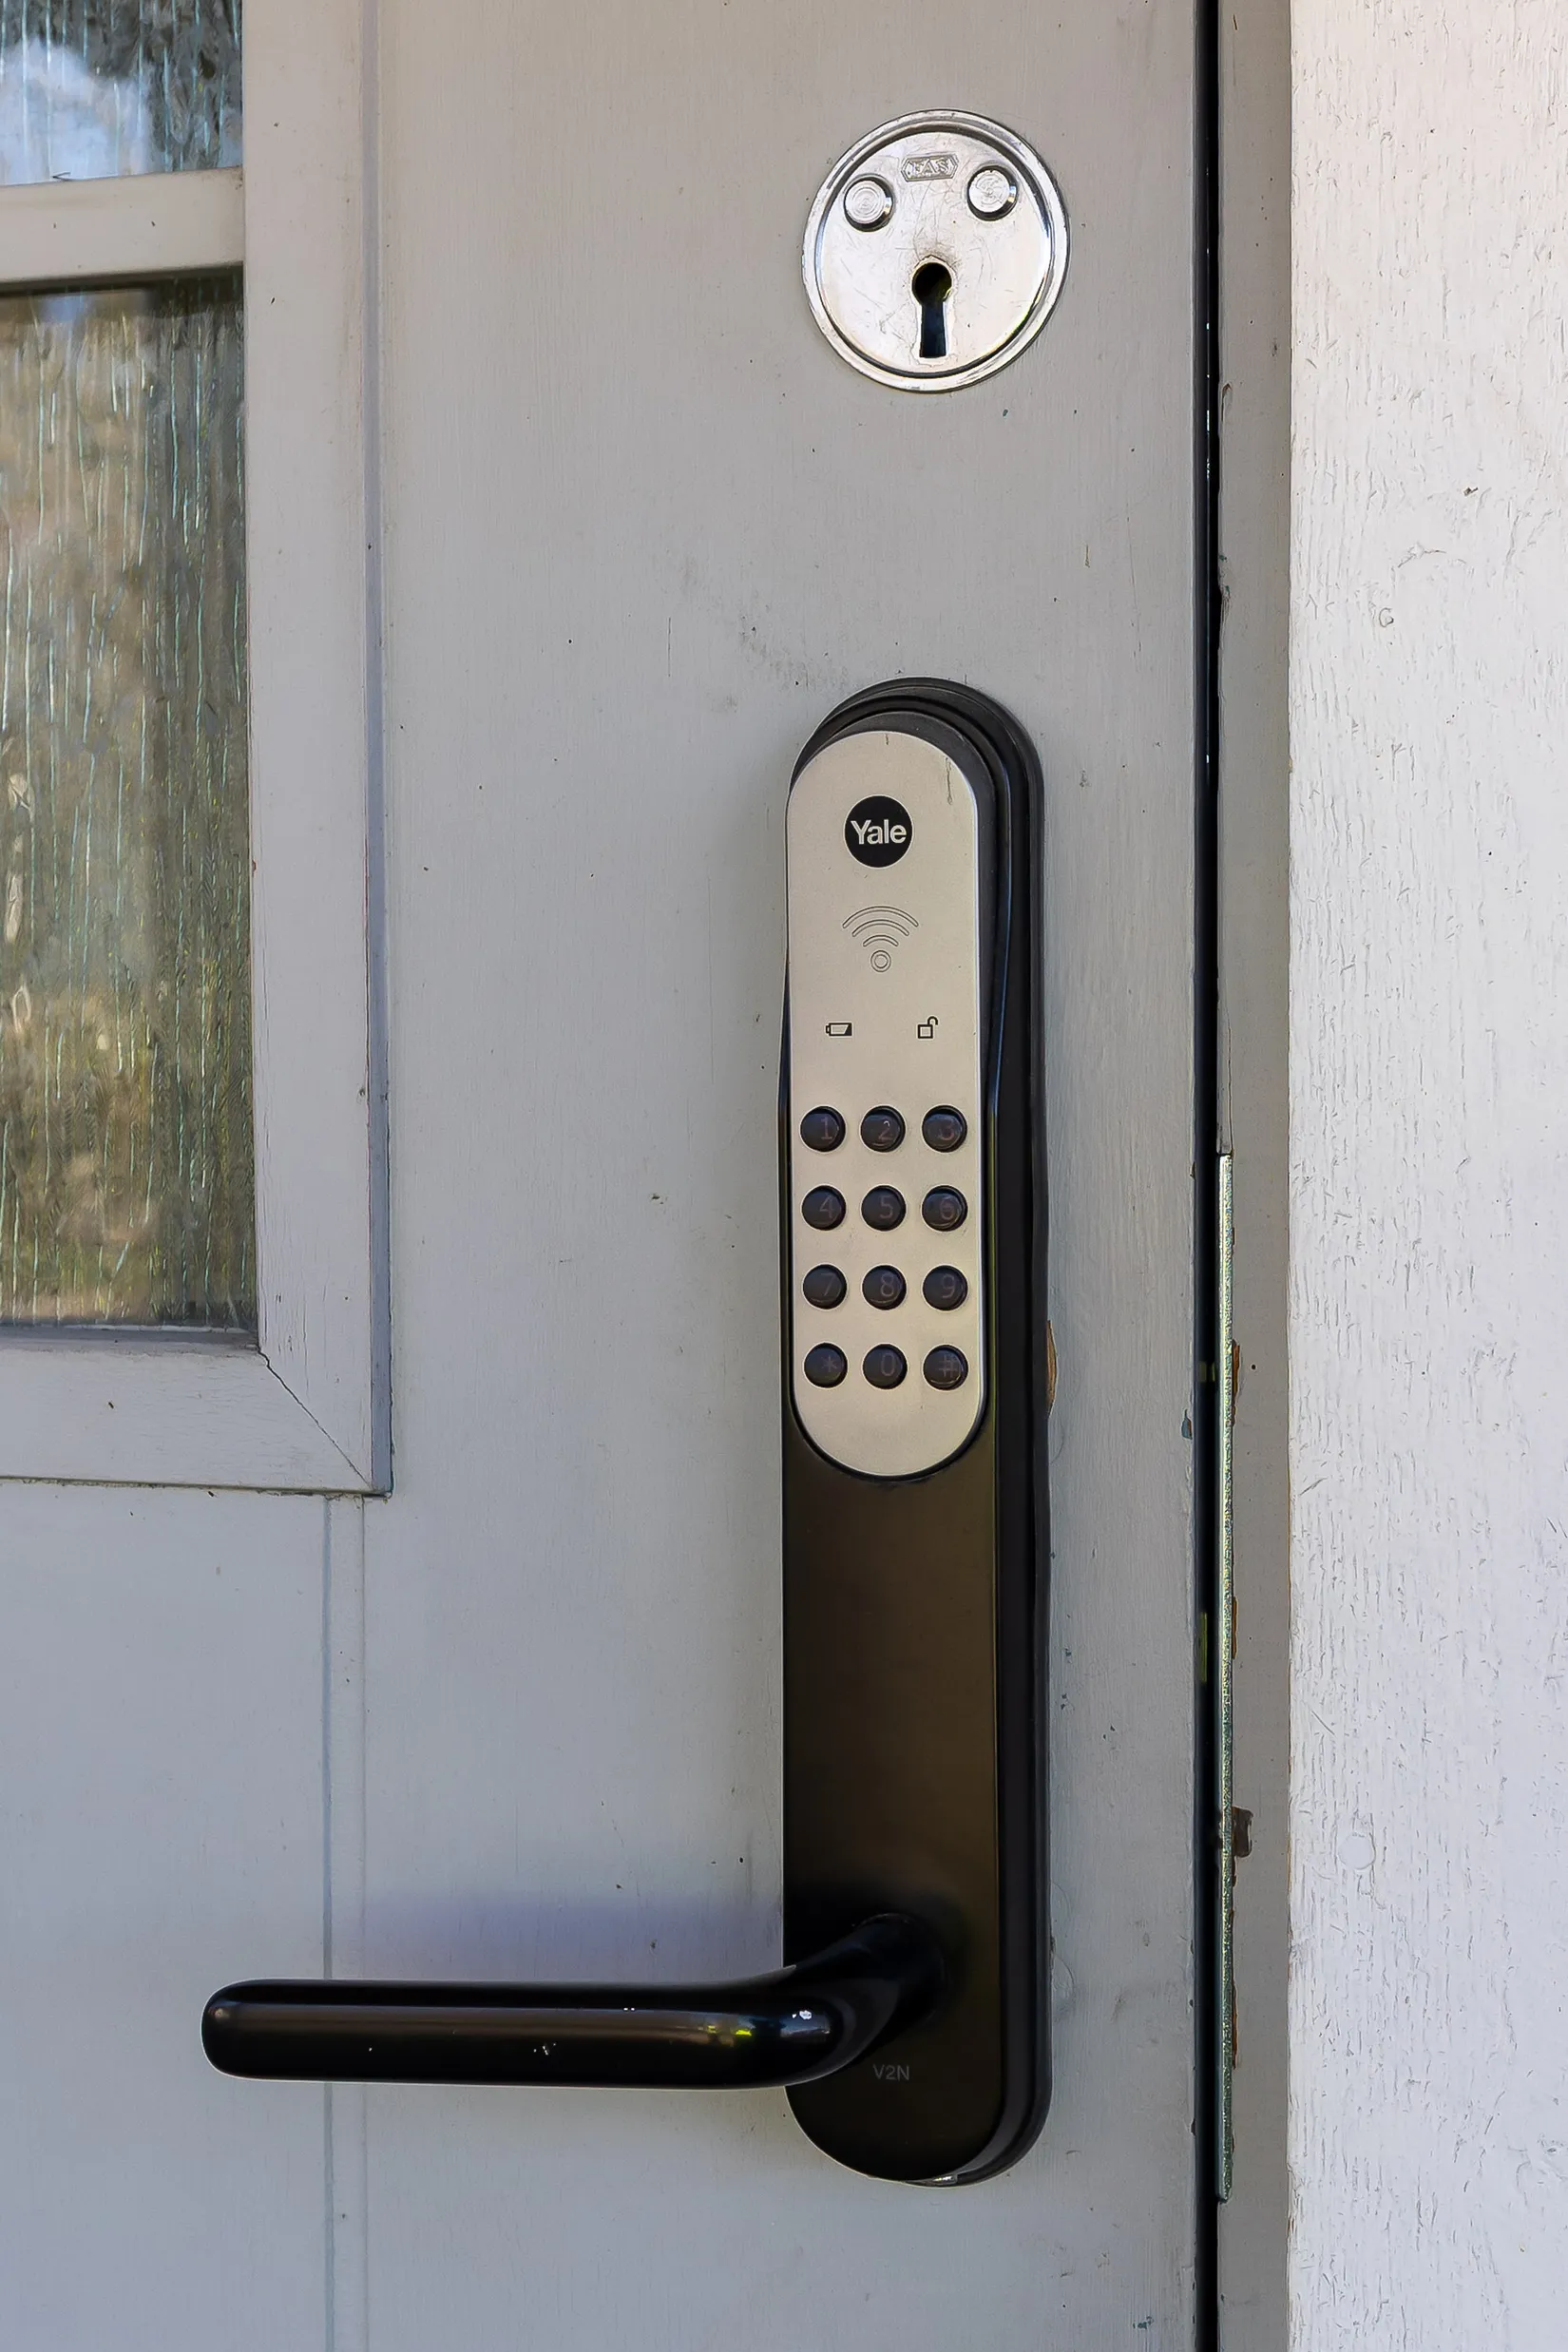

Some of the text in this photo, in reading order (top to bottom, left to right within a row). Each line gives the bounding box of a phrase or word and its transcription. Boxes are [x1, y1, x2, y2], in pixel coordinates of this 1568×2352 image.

[851, 819, 907, 844] Yale
[821, 1116, 955, 1141] 1 2 3
[819, 1194, 955, 1220] 4 5 6
[820, 1272, 956, 1298] 7 8 9
[880, 1352, 895, 1377] 0
[872, 2064, 909, 2081] V2N
